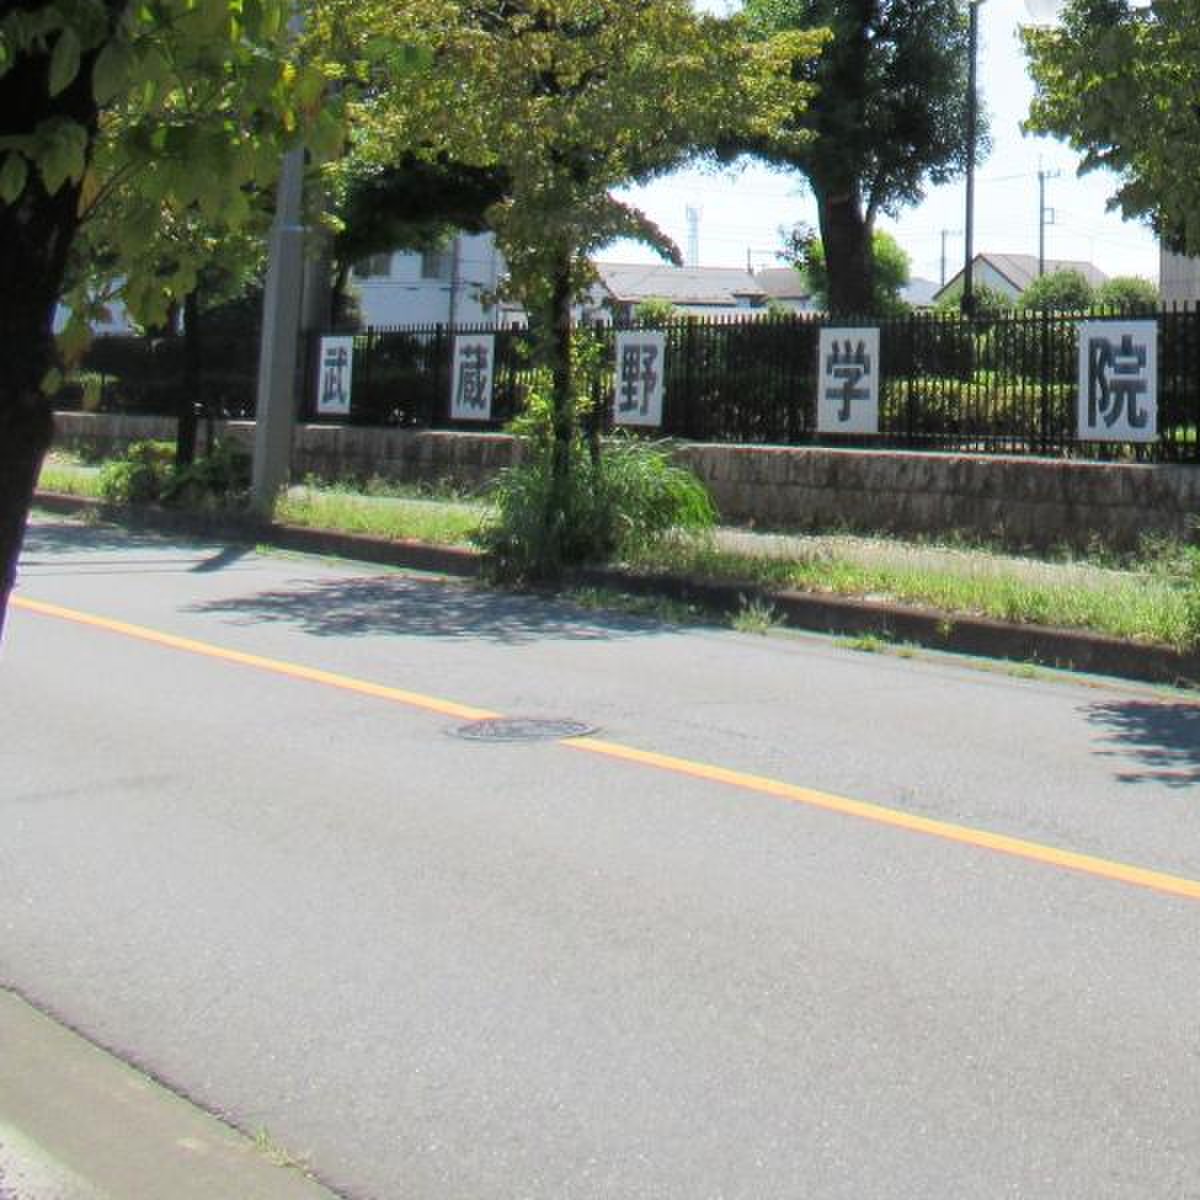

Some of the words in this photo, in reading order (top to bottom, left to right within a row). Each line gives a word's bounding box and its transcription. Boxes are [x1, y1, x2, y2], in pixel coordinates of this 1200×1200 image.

[322, 348, 348, 404] 武
[458, 346, 487, 411] 蔵
[620, 344, 659, 415] 野
[825, 340, 871, 422] 学
[1088, 334, 1148, 429] 院
